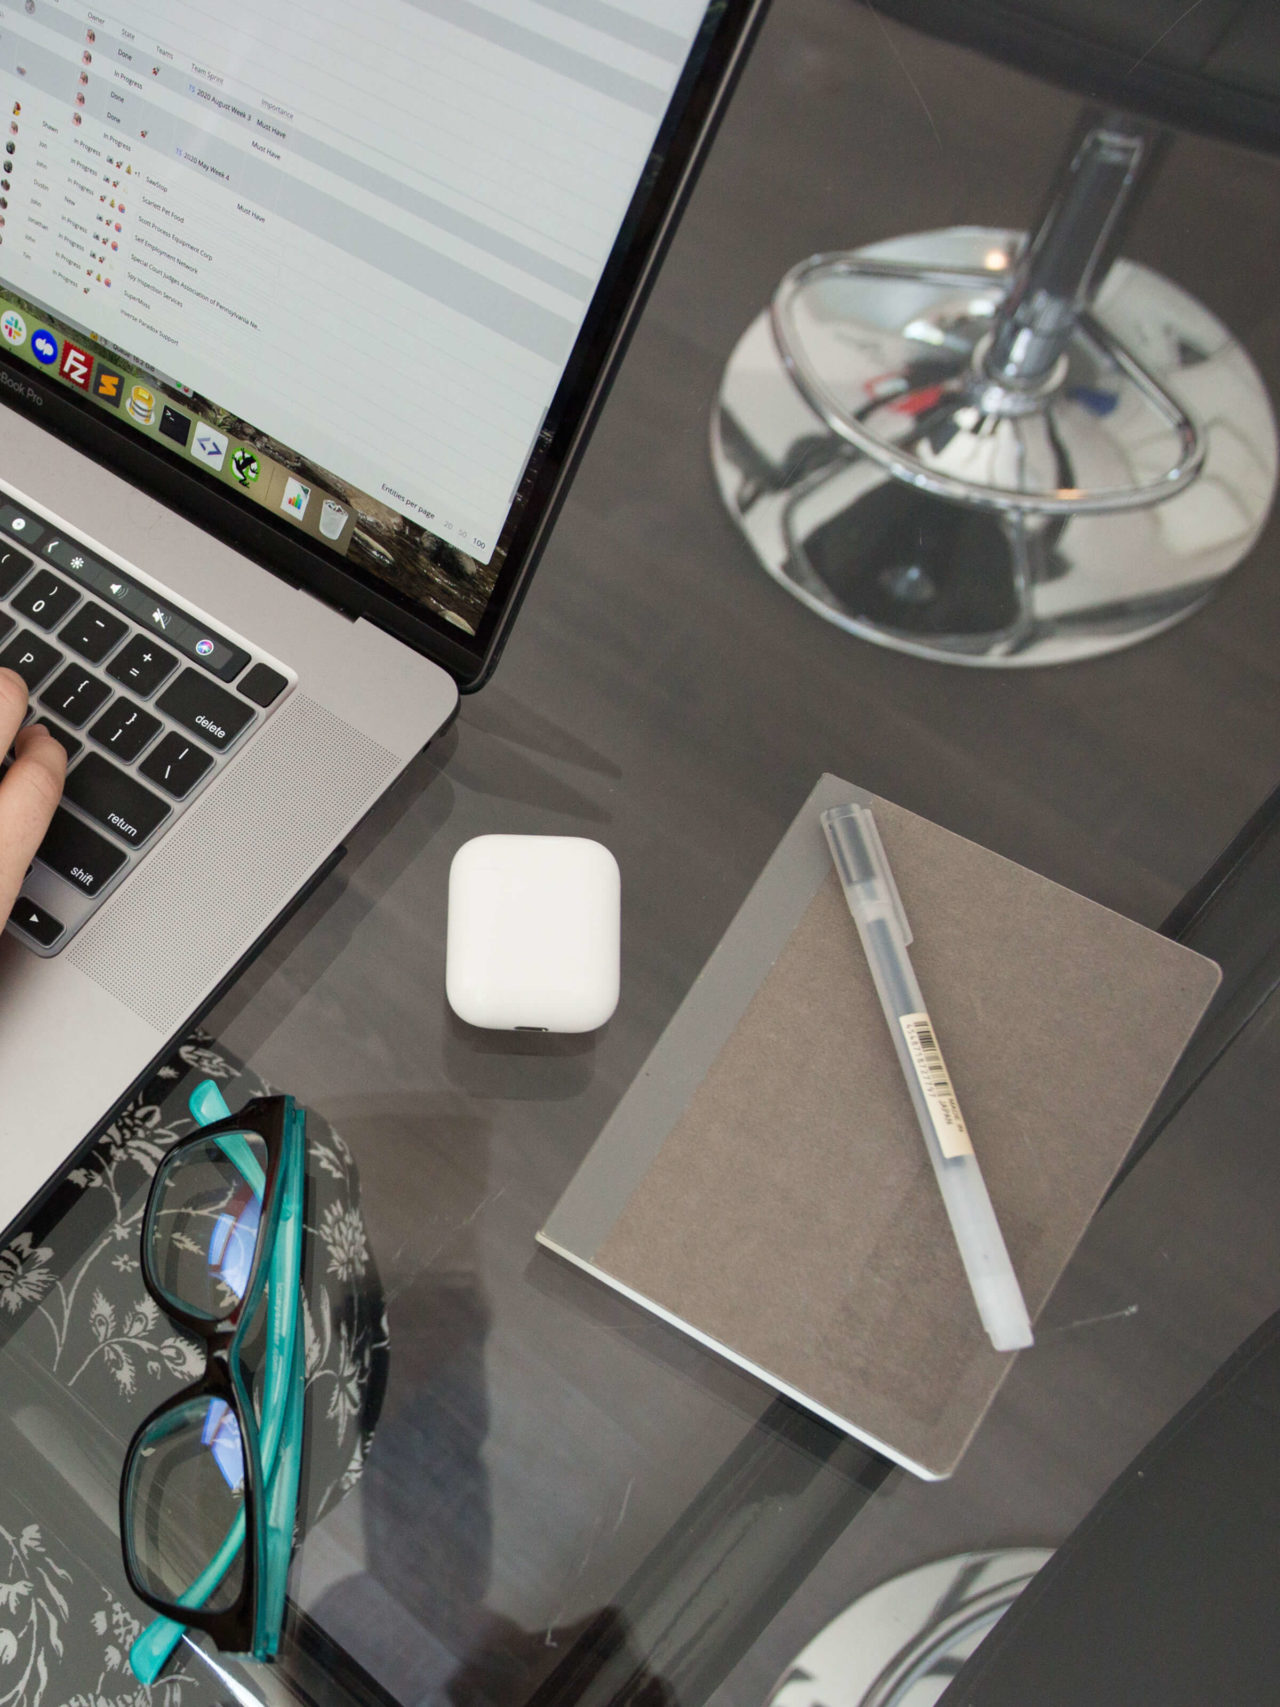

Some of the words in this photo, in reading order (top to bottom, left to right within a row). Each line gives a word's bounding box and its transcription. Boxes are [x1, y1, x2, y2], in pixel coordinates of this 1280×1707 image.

[87, 12, 105, 25] Owner
[121, 28, 135, 41] State
[117, 48, 132, 61] Done
[155, 45, 173, 60] Teams
[114, 69, 119, 77] In
[119, 72, 143, 91] Progress
[191, 63, 206, 76] Team
[206, 71, 223, 85] Sprint
[110, 91, 124, 103] Done
[196, 88, 210, 100] 2020
[211, 96, 230, 112] August
[231, 105, 246, 118] Week
[106, 111, 120, 124] Done
[260, 97, 293, 120] Importance
[256, 119, 270, 131] Must
[271, 126, 286, 139] Have
[79, 140, 101, 157] Progress
[103, 132, 108, 140] In
[108, 136, 131, 152] Progress
[251, 140, 266, 152] Must
[266, 148, 280, 160] Have
[76, 159, 97, 177] Progress
[183, 151, 197, 164] 2020
[197, 159, 209, 171] May
[209, 165, 224, 178] Week
[72, 179, 94, 196] Progress
[141, 195, 161, 211] Scarlett
[161, 206, 170, 216] Pet
[171, 211, 184, 224] Food
[236, 203, 251, 215] Must
[251, 210, 265, 223] Have
[137, 215, 150, 227] Scott
[151, 223, 171, 238] Process
[171, 234, 199, 255] Equipment
[199, 249, 213, 262] Corp
[134, 234, 144, 244] Self
[144, 240, 175, 263] Employment
[176, 257, 198, 274] Network
[130, 253, 148, 268] Special
[180, 281, 208, 302] Association
[209, 297, 215, 306] of
[215, 301, 249, 326] Pennsylvania
[136, 276, 162, 296] Inspection
[162, 291, 183, 308] Services
[138, 318, 158, 334] Paradox
[159, 330, 178, 347] Support
[26, 387, 43, 406] Pro
[381, 484, 404, 502] Entities
[406, 499, 417, 509] per
[418, 506, 435, 519] page
[444, 521, 453, 530] 20
[473, 538, 485, 549] 100
[2, 554, 9, 563] (
[50, 587, 57, 595] )
[33, 600, 45, 612] 0
[20, 653, 33, 663] P
[130, 668, 139, 676] =
[78, 681, 89, 692] {
[63, 696, 74, 707] [
[126, 713, 137, 724] }
[193, 716, 225, 741] delete
[111, 729, 122, 741] ]
[105, 813, 137, 839] return
[68, 868, 93, 888] shift
[939, 1100, 952, 1124] JAPAN
